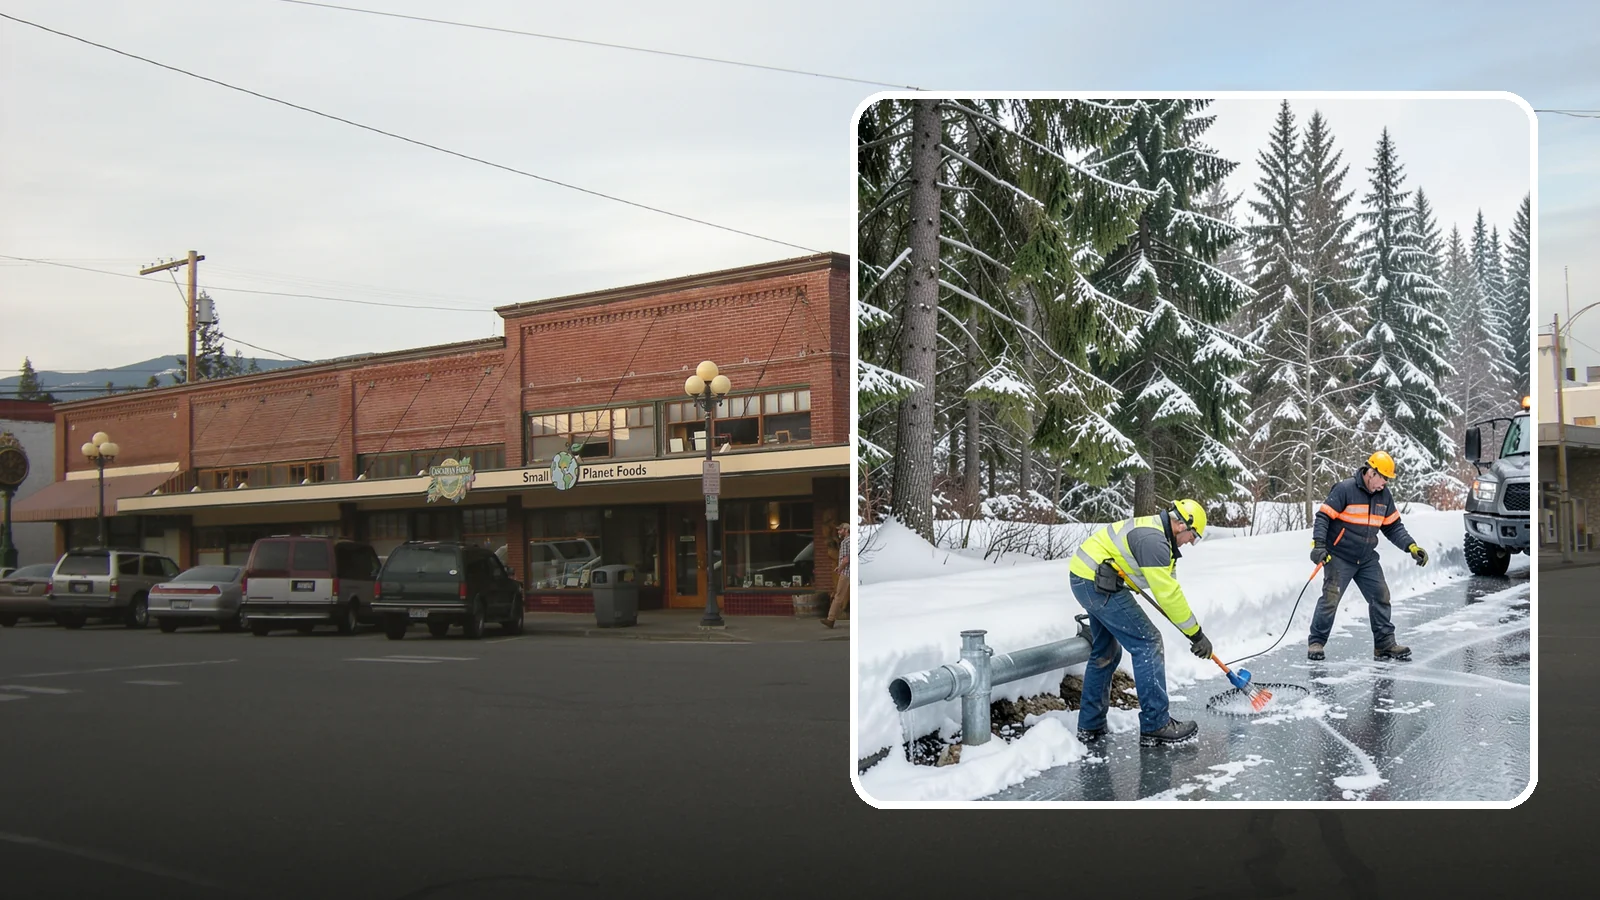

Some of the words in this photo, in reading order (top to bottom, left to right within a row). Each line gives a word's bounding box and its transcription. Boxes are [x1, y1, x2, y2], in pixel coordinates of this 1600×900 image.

[523, 471, 549, 483] Small
[583, 468, 614, 479] Planet
[617, 464, 647, 477] Foods
